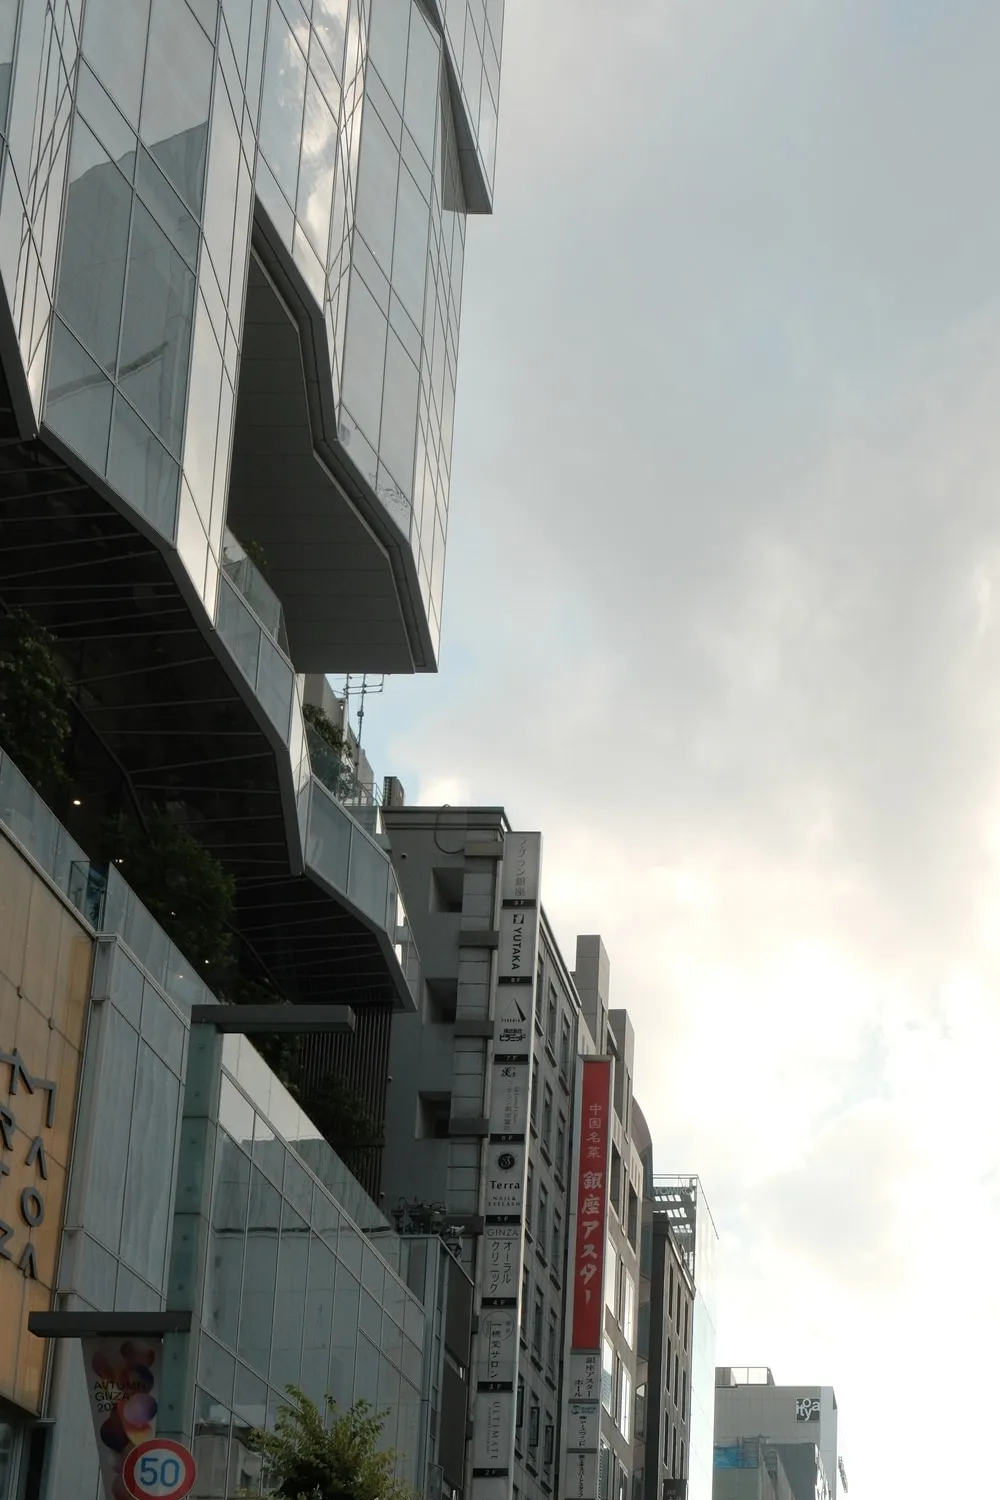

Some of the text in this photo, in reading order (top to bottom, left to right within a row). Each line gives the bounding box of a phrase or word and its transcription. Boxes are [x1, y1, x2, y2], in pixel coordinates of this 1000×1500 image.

[511, 927, 522, 970] YUTAKA
[585, 1102, 602, 1159] 中国名菜
[489, 1180, 521, 1190] Terra
[653, 1186, 696, 1195] YOMIKO
[487, 1228, 518, 1237] GINZA
[579, 1170, 603, 1305] 銀座アスター
[490, 1241, 500, 1294] クリニック
[502, 1241, 512, 1284] オーラル
[94, 1391, 130, 1401] GINZA
[573, 1379, 584, 1397] ホール
[796, 1398, 820, 1421] itoya
[491, 1401, 502, 1460] ULTIMATE
[139, 1457, 181, 1487] 50
